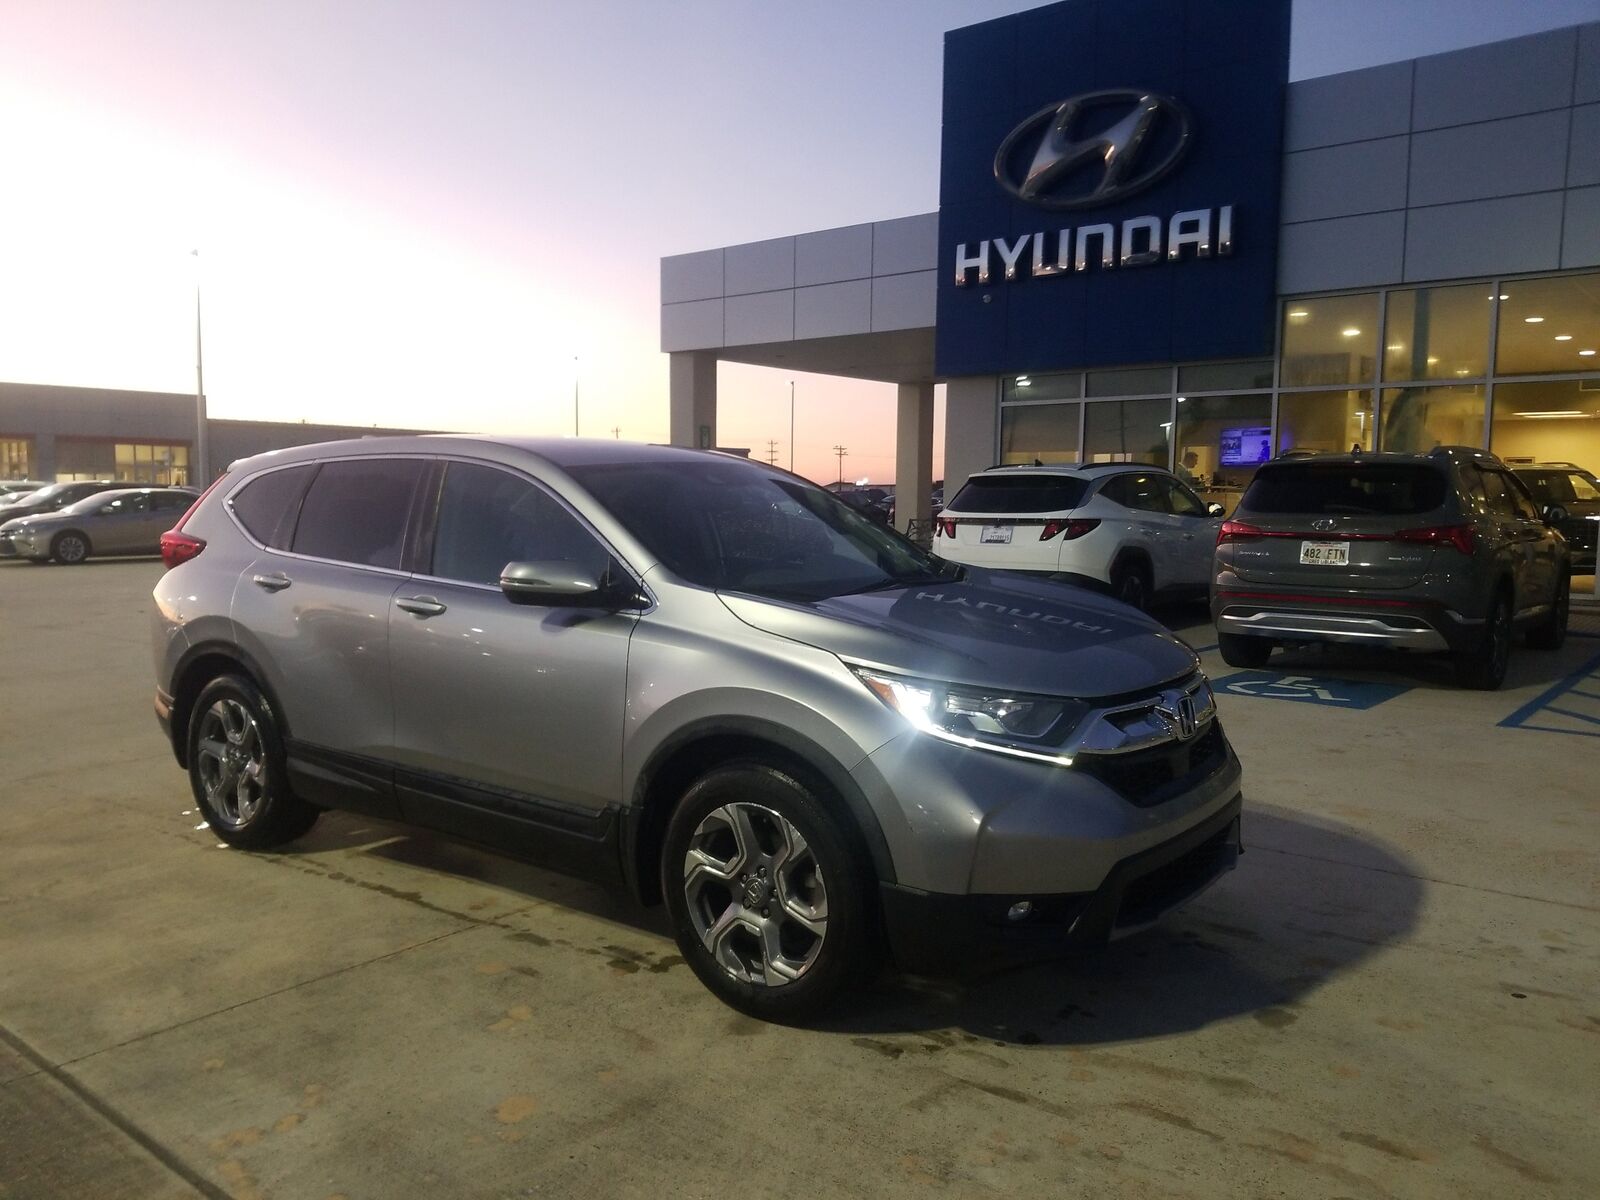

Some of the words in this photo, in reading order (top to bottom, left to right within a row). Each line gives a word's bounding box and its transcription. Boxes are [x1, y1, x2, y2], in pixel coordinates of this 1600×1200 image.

[955, 205, 1233, 287] HYUNDAI
[1303, 548, 1321, 559] 482
[1327, 549, 1346, 560] FTN
